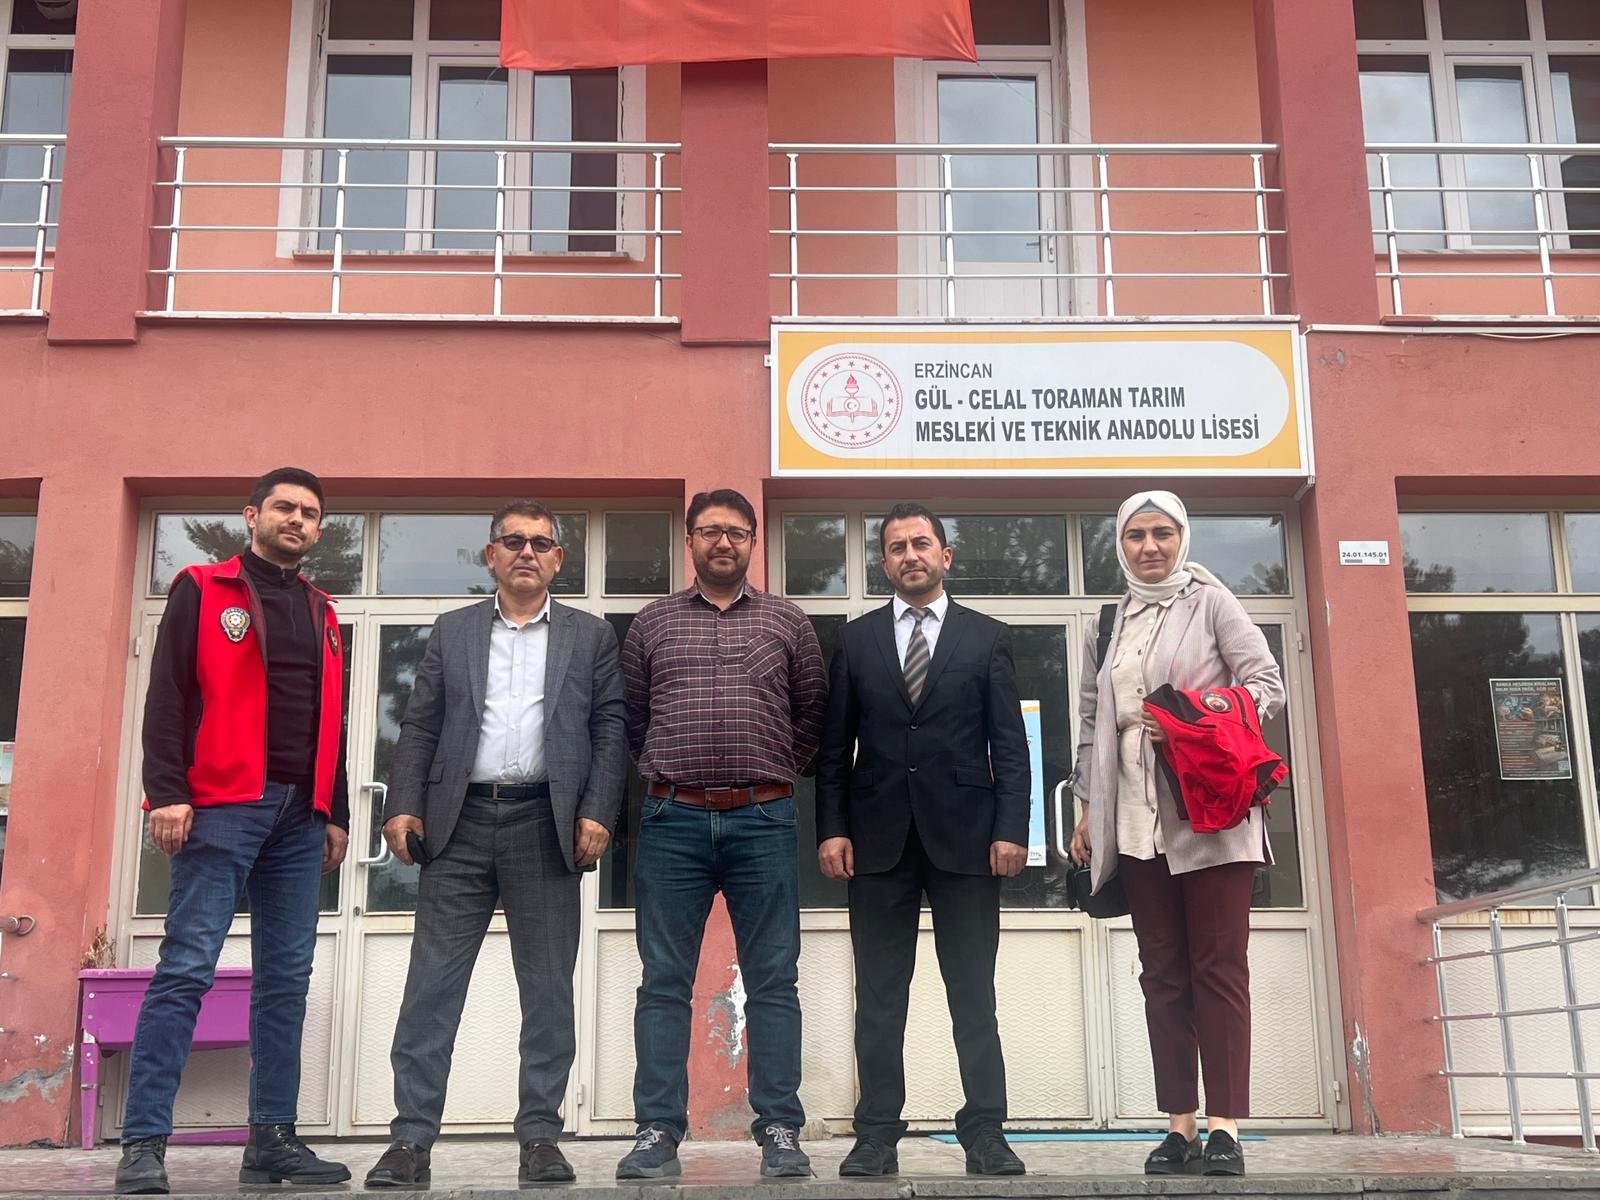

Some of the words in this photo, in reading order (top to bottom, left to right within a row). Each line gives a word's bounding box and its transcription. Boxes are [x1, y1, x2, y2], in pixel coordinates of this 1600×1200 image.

[914, 359, 992, 379] ERZİNCAN
[915, 385, 953, 410] GÜL
[968, 389, 1027, 410] CELAL
[1031, 387, 1122, 410] TORAMAN
[1127, 386, 1185, 408] TARIM
[916, 416, 996, 442] MESLEKİ
[1001, 421, 1026, 442] VE
[1030, 415, 1102, 442] TEKNİK
[1107, 418, 1195, 441] ANADOLU
[1201, 413, 1260, 440] LİSESİ
